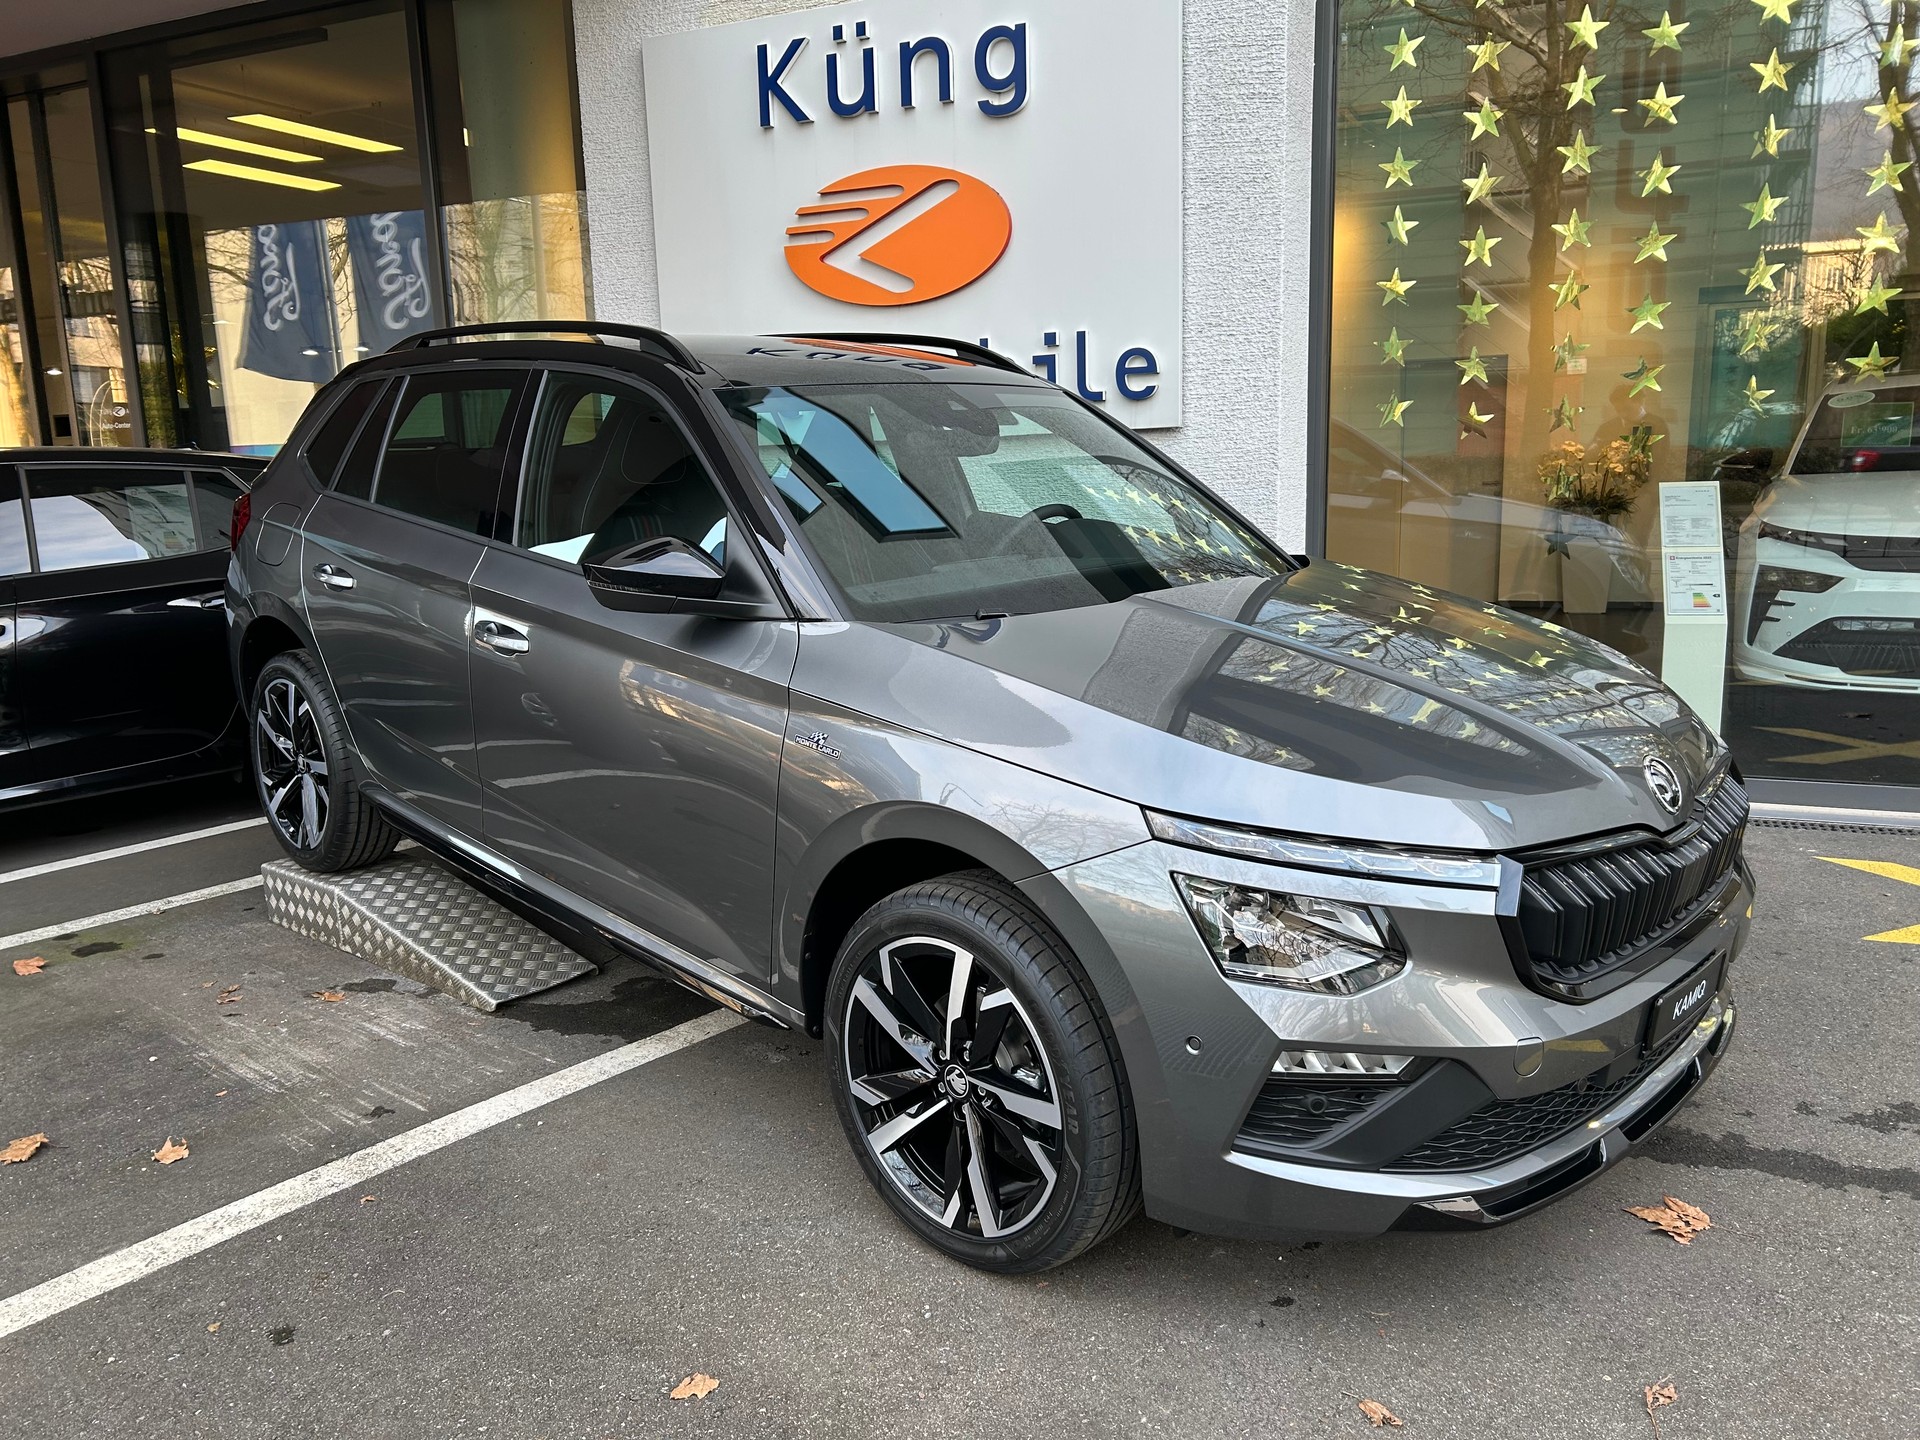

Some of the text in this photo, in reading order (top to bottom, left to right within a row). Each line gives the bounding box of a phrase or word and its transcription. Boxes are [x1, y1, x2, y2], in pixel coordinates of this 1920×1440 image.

[757, 20, 1029, 127] Küng
[979, 330, 1160, 402] ile
[795, 736, 839, 757] MONTE CARLO
[1672, 979, 1707, 1020] KAMIQ
